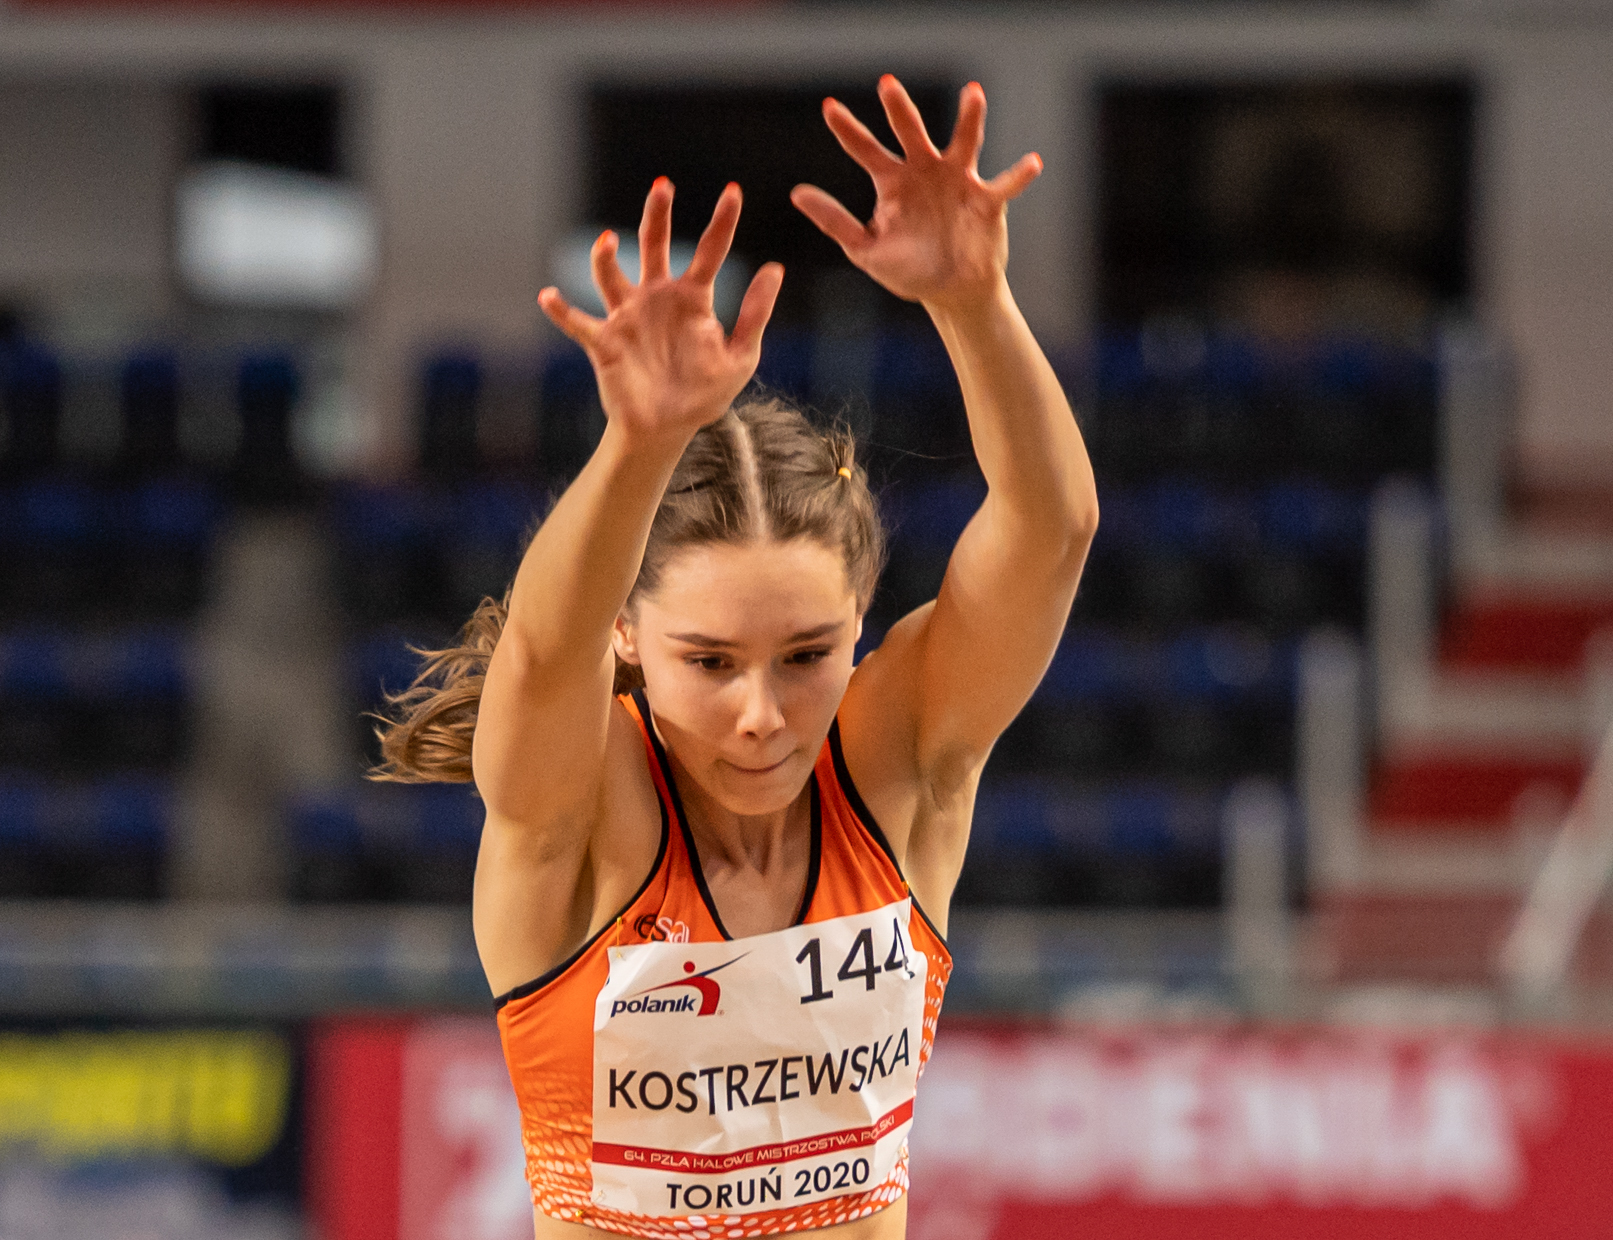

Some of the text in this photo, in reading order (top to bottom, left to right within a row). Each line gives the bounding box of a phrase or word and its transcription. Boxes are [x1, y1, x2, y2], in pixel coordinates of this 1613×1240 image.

[796, 917, 915, 1005] 144
[610, 994, 697, 1018] polanik
[608, 1027, 911, 1116] KOSTRZEWSKA
[623, 1115, 895, 1169] 64. PZLA HALOWE MISTRZOSTWA POLSKI
[666, 1157, 870, 1210] TORUŃ 2020
